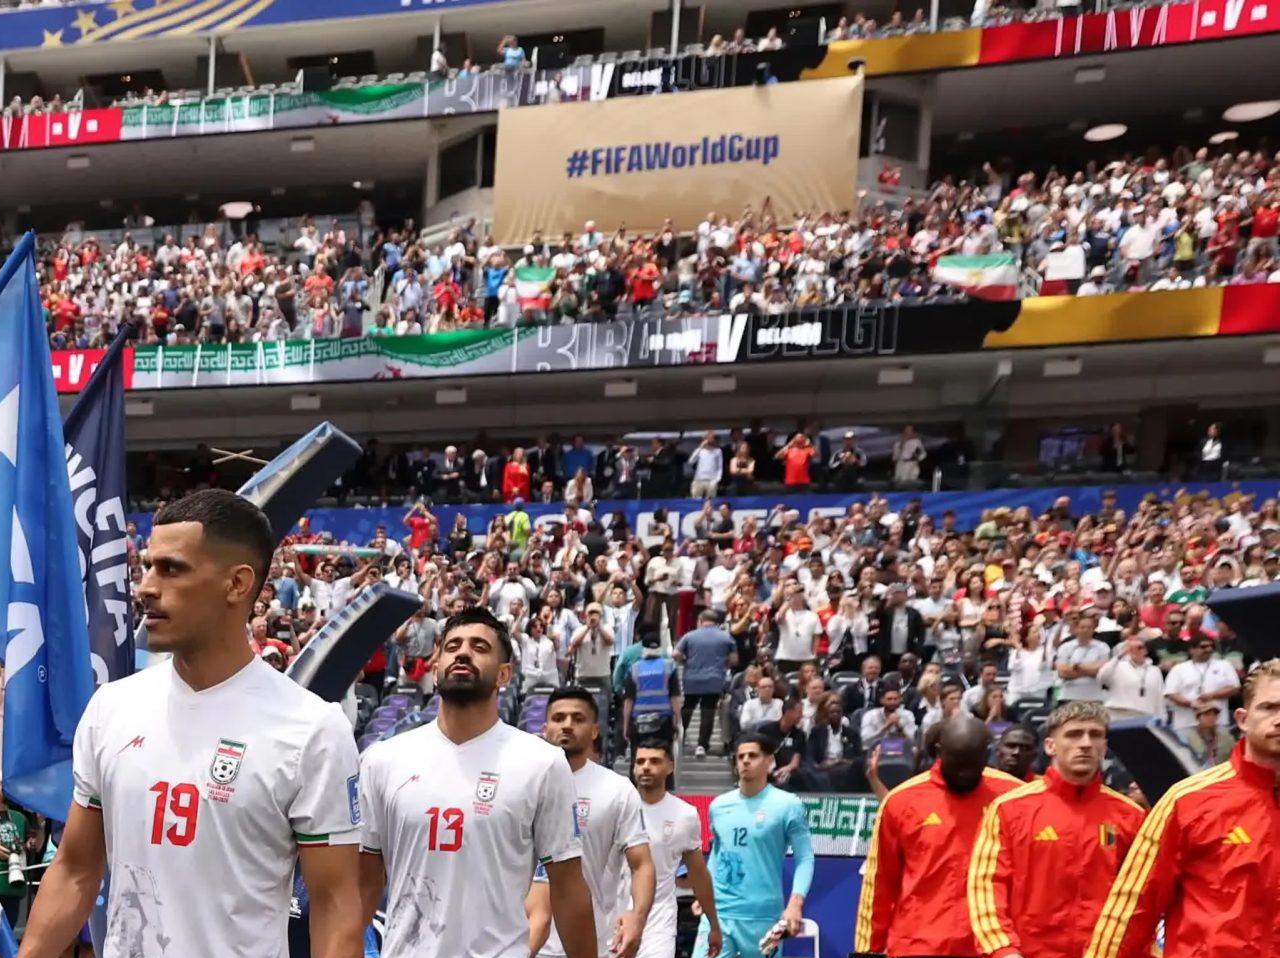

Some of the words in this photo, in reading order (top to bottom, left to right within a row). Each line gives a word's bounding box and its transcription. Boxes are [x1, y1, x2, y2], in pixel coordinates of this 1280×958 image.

[566, 133, 780, 179] #FIFAWorldCup
[149, 781, 199, 847] 19
[425, 806, 465, 852] 13
[732, 827, 748, 847] 12
